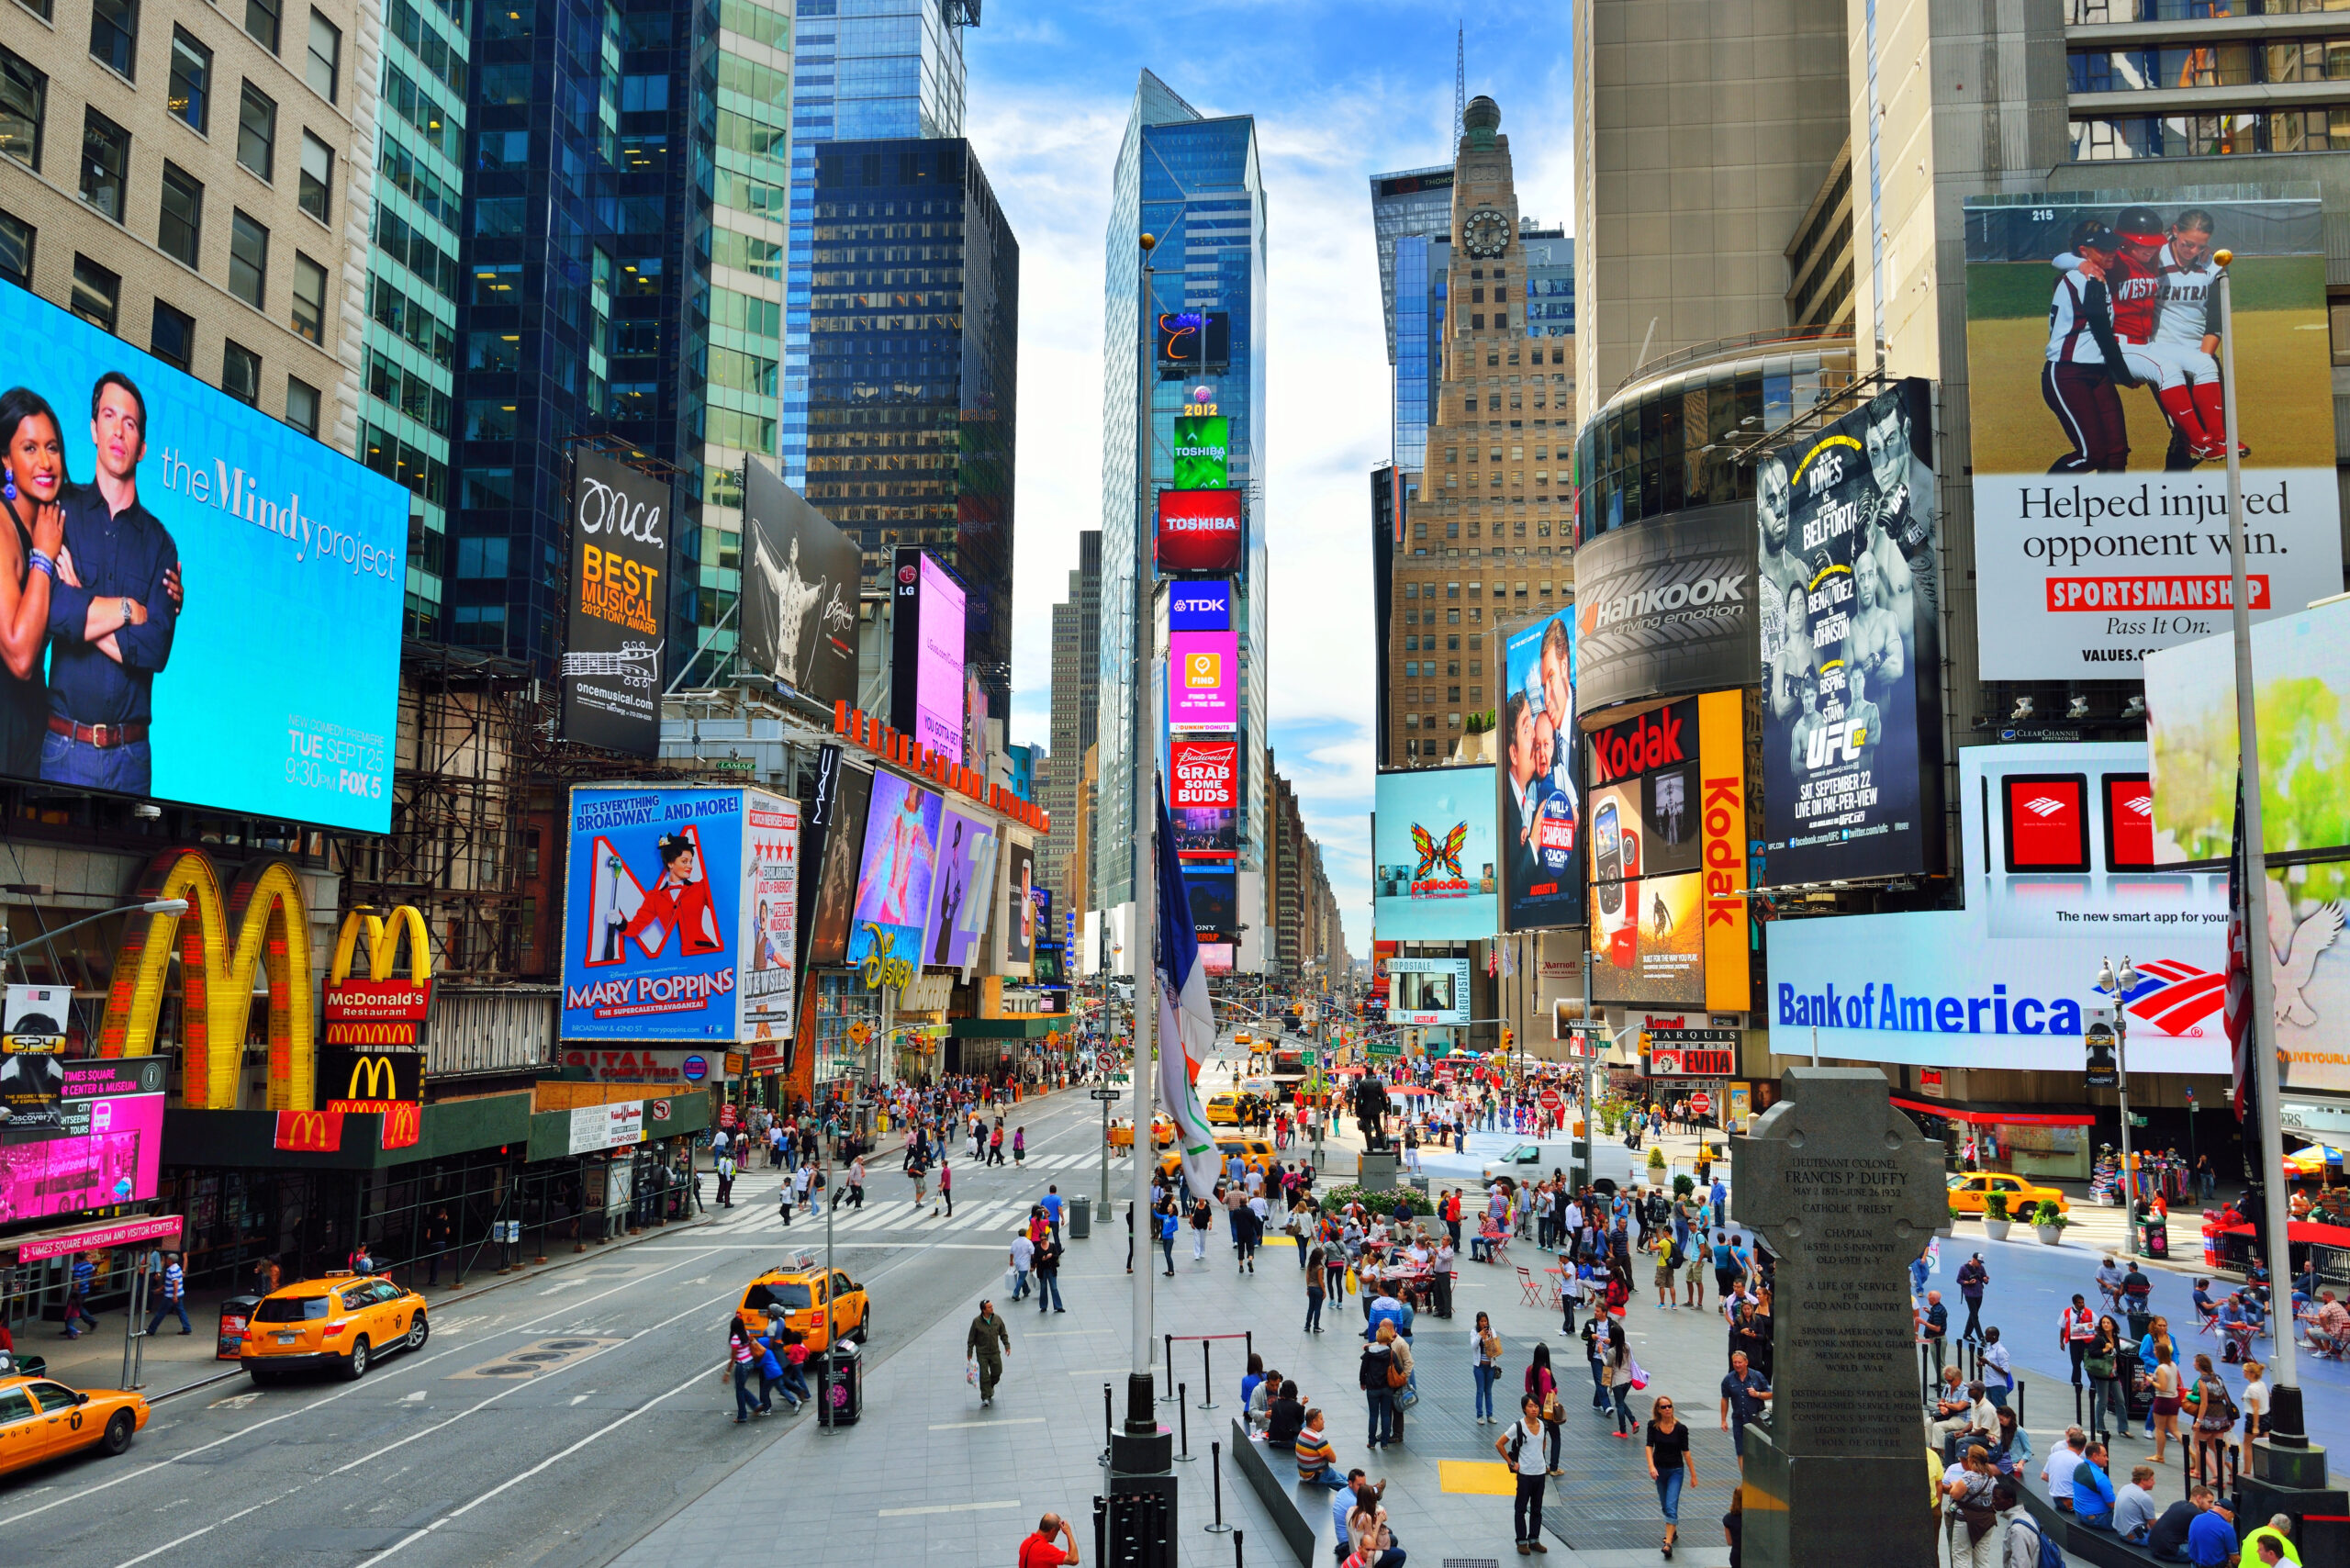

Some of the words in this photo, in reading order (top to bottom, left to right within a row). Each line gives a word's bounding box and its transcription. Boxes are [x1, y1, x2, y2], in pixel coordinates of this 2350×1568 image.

[2032, 209, 2053, 221] 215
[1184, 404, 1218, 417] 2012
[1176, 447, 1225, 456] TOSHIBA
[1808, 454, 1843, 498] JONES
[2019, 484, 2151, 527] Helped
[1167, 518, 1236, 531] TOSHIBA
[1802, 501, 1853, 551] BELFORT
[2023, 531, 2198, 567] opponent
[2207, 522, 2288, 555] win.
[583, 543, 658, 601] BEST
[900, 586, 914, 596] LG
[1807, 578, 1854, 614] BENAVIDEZ
[2053, 578, 2263, 608] SPORTSMANSHP
[581, 579, 656, 624] MUSICAL
[1185, 599, 1225, 611] TDK
[581, 601, 601, 618] 2012
[602, 608, 626, 625] TONY
[626, 617, 656, 635] AWARD
[1614, 616, 1662, 636] driving
[1663, 604, 1744, 624] emotion
[2106, 617, 2146, 635] Pass
[2152, 616, 2168, 634] It
[1813, 617, 1850, 649] JOHNSON
[1192, 677, 1214, 685] FIND
[576, 682, 654, 711] oncemusical.com
[1822, 702, 1844, 724] STANN
[310, 719, 345, 737] COMEDY
[288, 729, 324, 759] TUE
[326, 738, 366, 769] SEPT
[366, 748, 385, 772] 25
[1595, 706, 1684, 783] Kodak
[1807, 718, 1863, 769] UFC
[1852, 728, 1868, 747] 152
[1177, 752, 1232, 763] Budweiser
[721, 762, 753, 770] LAMAR
[1177, 767, 1230, 779] GRAB
[339, 768, 369, 798] FOX
[371, 776, 382, 799] 5
[1184, 779, 1223, 790] SOME
[1800, 782, 1815, 801] SAT.
[1816, 773, 1859, 798] SEPTEMBER
[1861, 770, 1871, 789] 22
[1178, 790, 1229, 802] BUDS
[1795, 800, 1810, 819] LIVE
[1811, 798, 1822, 817] ON
[1823, 787, 1878, 814] PAY-PER-VIEW
[581, 802, 597, 814] IT'S
[599, 795, 659, 813] EVERYTHING
[1550, 800, 1566, 814] WILL
[576, 808, 661, 832] BROADWAY...
[664, 803, 692, 821] AND
[695, 797, 739, 817] MORE!
[1542, 824, 1572, 847] CAMPAIGN
[1547, 848, 1565, 864] ZACH
[1705, 777, 1743, 927] Kodak
[1411, 878, 1469, 893] palladia
[1530, 884, 1550, 896] AUGUST
[2056, 911, 2080, 922] The
[2083, 913, 2109, 922] new
[2112, 912, 2150, 922] smart
[2154, 913, 2178, 924] app
[2182, 911, 2199, 922] for
[1543, 961, 1576, 969] Marriott
[567, 979, 634, 1010] MARY
[637, 967, 735, 1003] POPPINS
[328, 992, 424, 1006] McDonald's
[342, 1008, 407, 1016] Restaurant
[599, 1008, 612, 1016] THE
[613, 1001, 704, 1015] SUPERCALEXTRAVAGANZA!
[1778, 982, 1843, 1028] Bank
[1846, 982, 1874, 1029] of
[1879, 983, 2083, 1036] America
[648, 1026, 699, 1035] marypoppins.com
[1650, 1031, 1736, 1039] MARQUIS
[12, 1036, 57, 1051] SPY
[2088, 1036, 2111, 1044] SPY
[567, 1051, 657, 1066] GITAL
[1684, 1050, 1730, 1073] EVITA
[64, 1070, 86, 1081] TIMES
[88, 1069, 116, 1081] SQUARE
[599, 1068, 679, 1077] COMPUTERS
[70, 1086, 97, 1095] CENTER
[106, 1081, 137, 1092] MUSEUM
[78, 1103, 91, 1113] CITY
[70, 1126, 89, 1135] TOURS
[1793, 1158, 1849, 1168] LIEUTENANT
[1852, 1159, 1897, 1169] COLONEL
[1785, 1170, 1842, 1183] FRANCIS
[1861, 1171, 1908, 1185] DUFFY
[1802, 1204, 1852, 1213] CATHOLIC
[1857, 1204, 1893, 1214] PRIEST
[31, 1242, 53, 1256] TIMES
[54, 1239, 81, 1253] SQUARE
[83, 1235, 111, 1246] MUSEUM
[113, 1230, 126, 1240] AND
[128, 1226, 150, 1237] VISITOR
[151, 1222, 173, 1235] CENTER
[1825, 1228, 1873, 1238] CHAPLAIN
[1817, 1255, 1836, 1264] OLD
[1818, 1282, 1837, 1291] LIFE
[1841, 1282, 1853, 1291] OF
[1858, 1282, 1897, 1292] SERVICE
[1803, 1301, 1826, 1310] GOD
[1830, 1302, 1851, 1310] AND
[1854, 1302, 1900, 1312] COUNTRY
[1802, 1327, 1835, 1336] SPANISH
[1839, 1327, 1883, 1336] AMERICAN
[1886, 1328, 1904, 1337] WAR
[1792, 1339, 1809, 1348] NEW
[1813, 1339, 1835, 1348] YORK
[1885, 1340, 1916, 1349] GUARD
[1816, 1351, 1853, 1360] MEXICAN
[1858, 1352, 1893, 1361] BORDER
[1863, 1364, 1884, 1372] WAR
[1791, 1389, 1854, 1397] DISTINGUISHED
[1856, 1390, 1889, 1398] SERVICE
[1893, 1390, 1920, 1398] CROSS
[1791, 1401, 1854, 1410] DISTINGUISHED
[1857, 1402, 1890, 1410] SERVICE
[1893, 1403, 1921, 1411] MEDAL
[1792, 1414, 1853, 1422] CONSPICUOUS
[1858, 1414, 1890, 1423] SERVICE
[1894, 1415, 1920, 1423] CROSS
